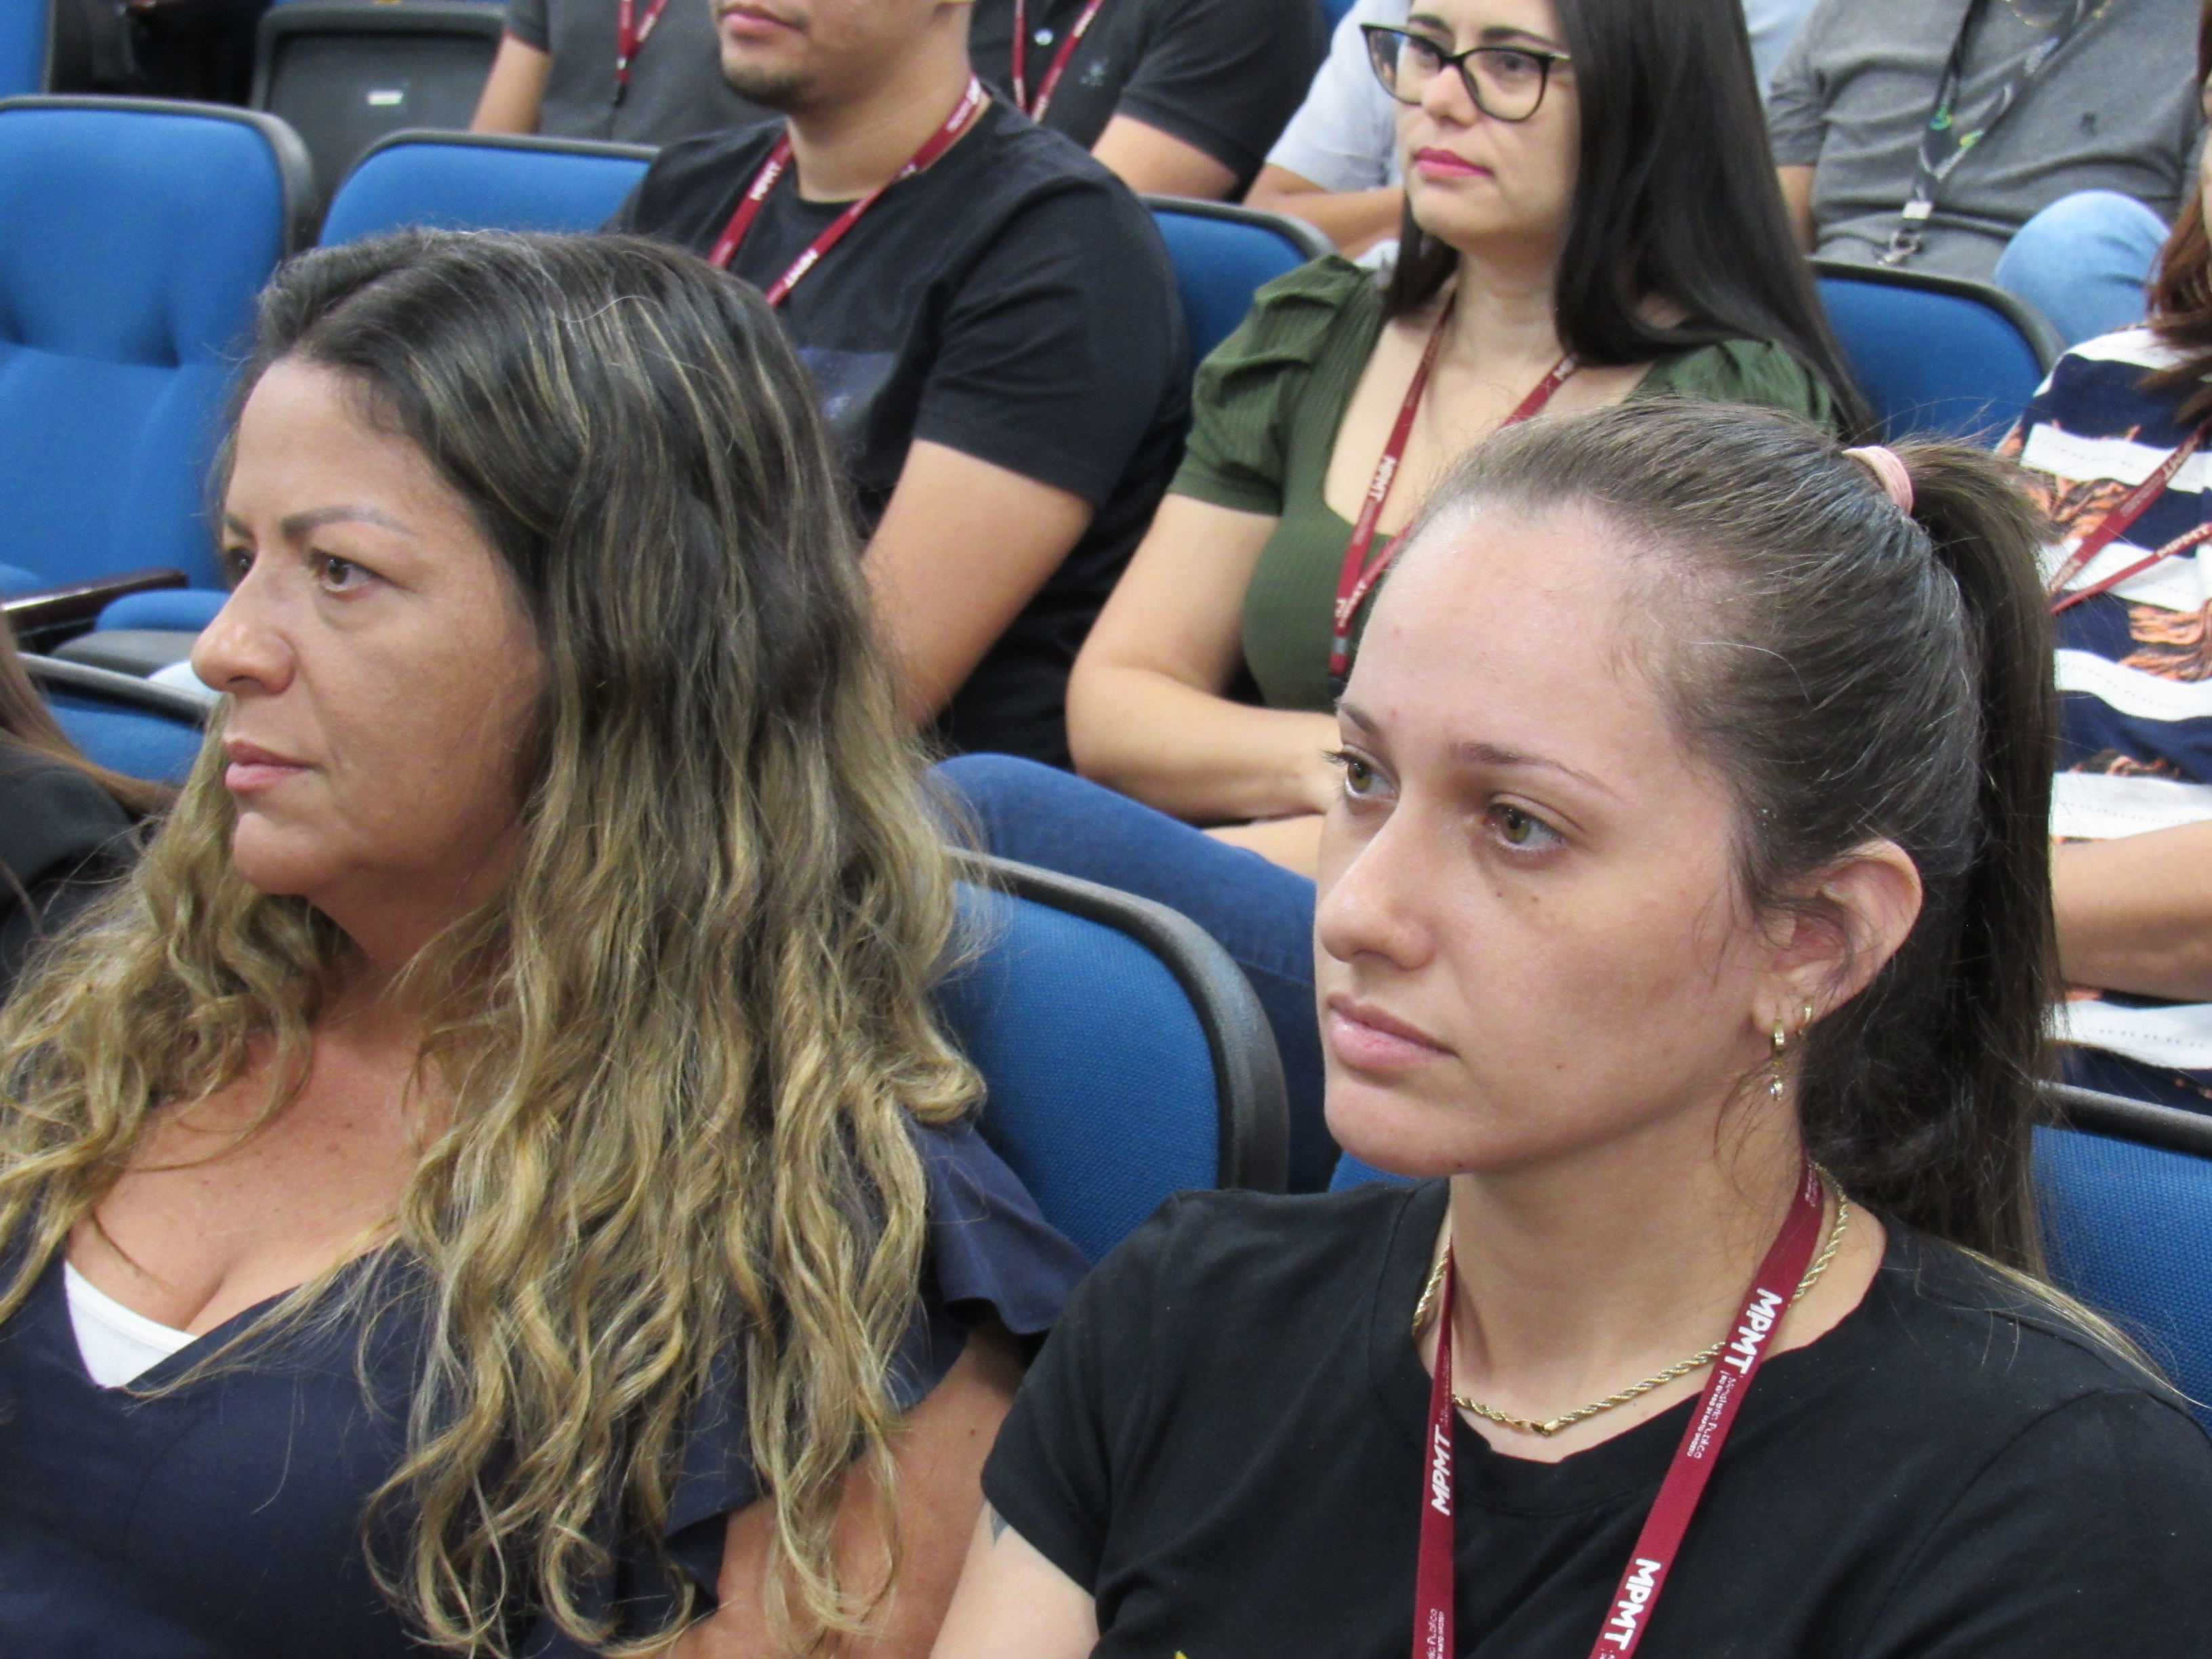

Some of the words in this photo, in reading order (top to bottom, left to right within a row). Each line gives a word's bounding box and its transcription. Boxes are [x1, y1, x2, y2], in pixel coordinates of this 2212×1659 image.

[1724, 1288, 1782, 1374] MPMT
[1431, 1424, 1452, 1515] MPMT
[1603, 1558, 1662, 1651] MPMT
